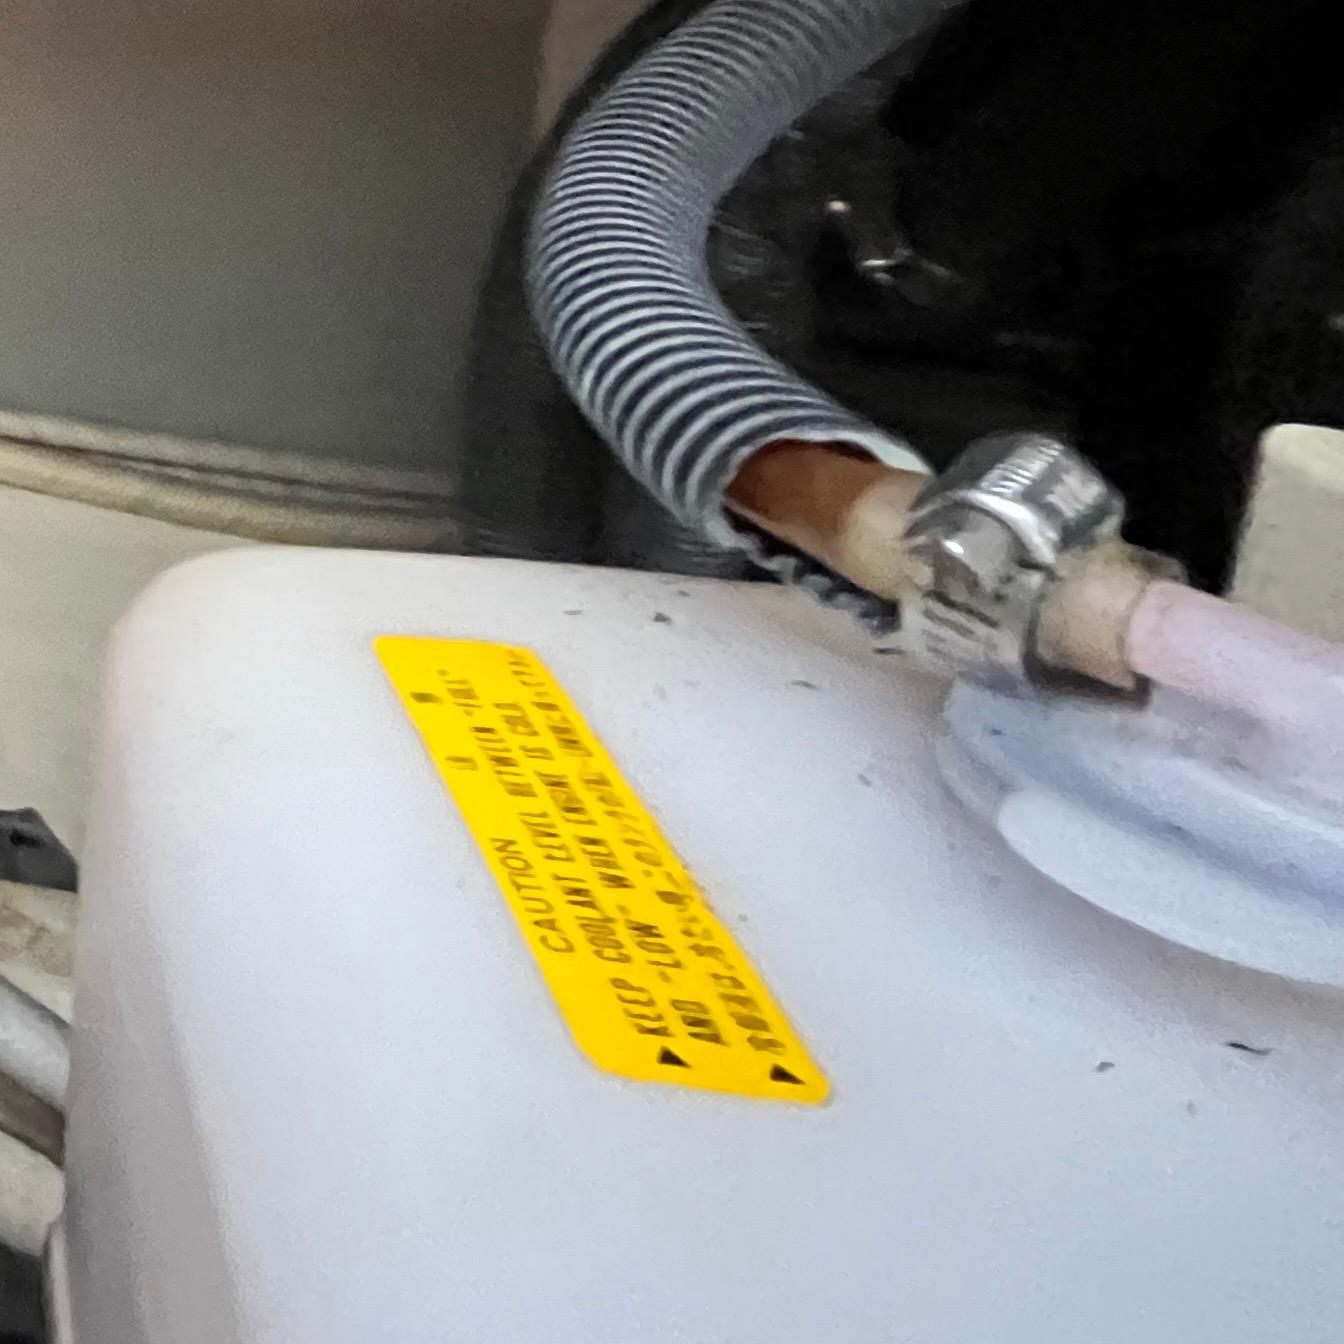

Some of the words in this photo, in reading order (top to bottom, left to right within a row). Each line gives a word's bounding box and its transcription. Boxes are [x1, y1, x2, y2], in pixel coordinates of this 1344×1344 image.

[488, 836, 577, 954] CAUTION
[550, 871, 633, 965] COOLANT
[607, 976, 677, 1039] KEEP
[667, 997, 731, 1048] AND
